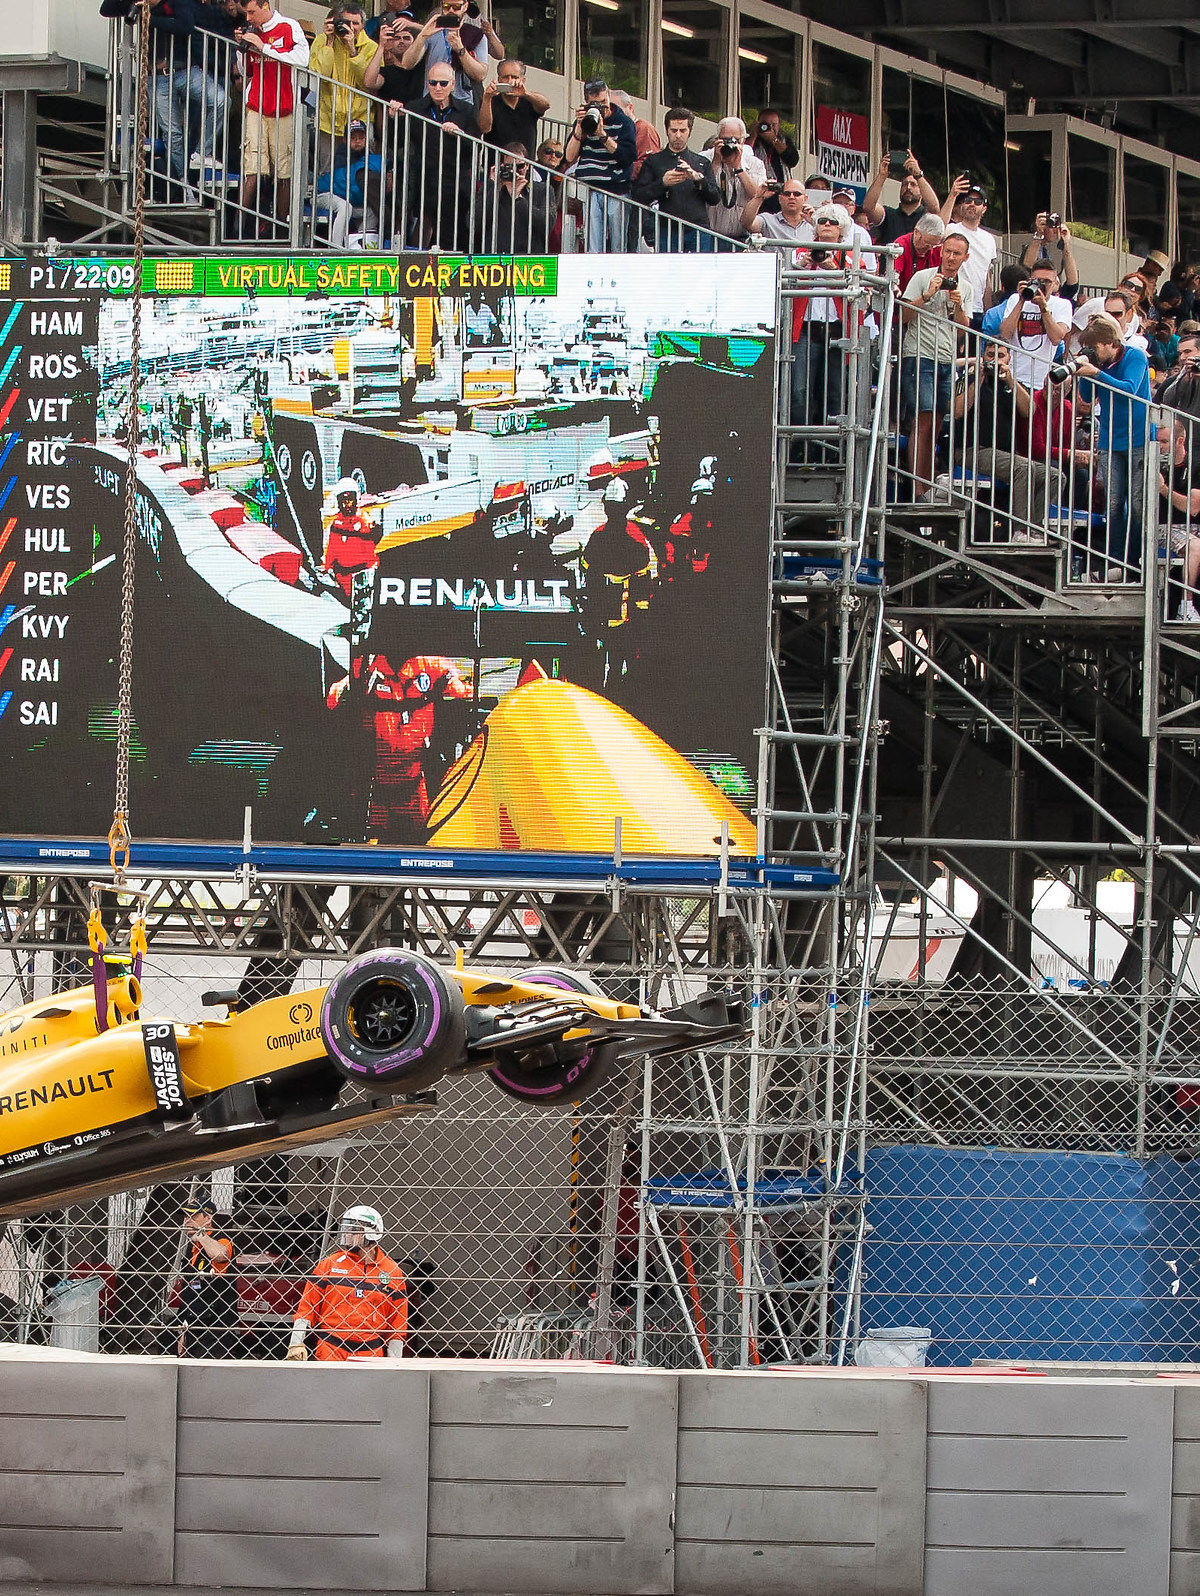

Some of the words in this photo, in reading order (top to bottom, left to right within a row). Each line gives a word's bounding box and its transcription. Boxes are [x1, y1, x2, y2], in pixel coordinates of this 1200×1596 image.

[832, 113, 852, 145] MAX
[218, 264, 310, 288] VIRTUAL
[316, 264, 399, 288] SAFETY
[405, 264, 451, 287] CAR
[459, 264, 546, 287] ENDING
[30, 311, 83, 336] HAM
[29, 353, 78, 379] ROS
[27, 397, 72, 422] VET
[27, 440, 66, 466] RIC
[25, 484, 71, 509] VES
[24, 527, 71, 552] HUL
[23, 571, 68, 595] PER
[379, 577, 569, 607] RENAULT
[22, 614, 70, 639] KVY
[20, 657, 60, 682] RAI
[19, 701, 58, 725] SAI
[39, 848, 90, 857] ENTREPOSE
[400, 859, 454, 868] ENTREPOSE
[153, 1064, 172, 1110] JACK
[13, 1149, 40, 1162] ELYSIUM
[83, 1133, 100, 1143] Office
